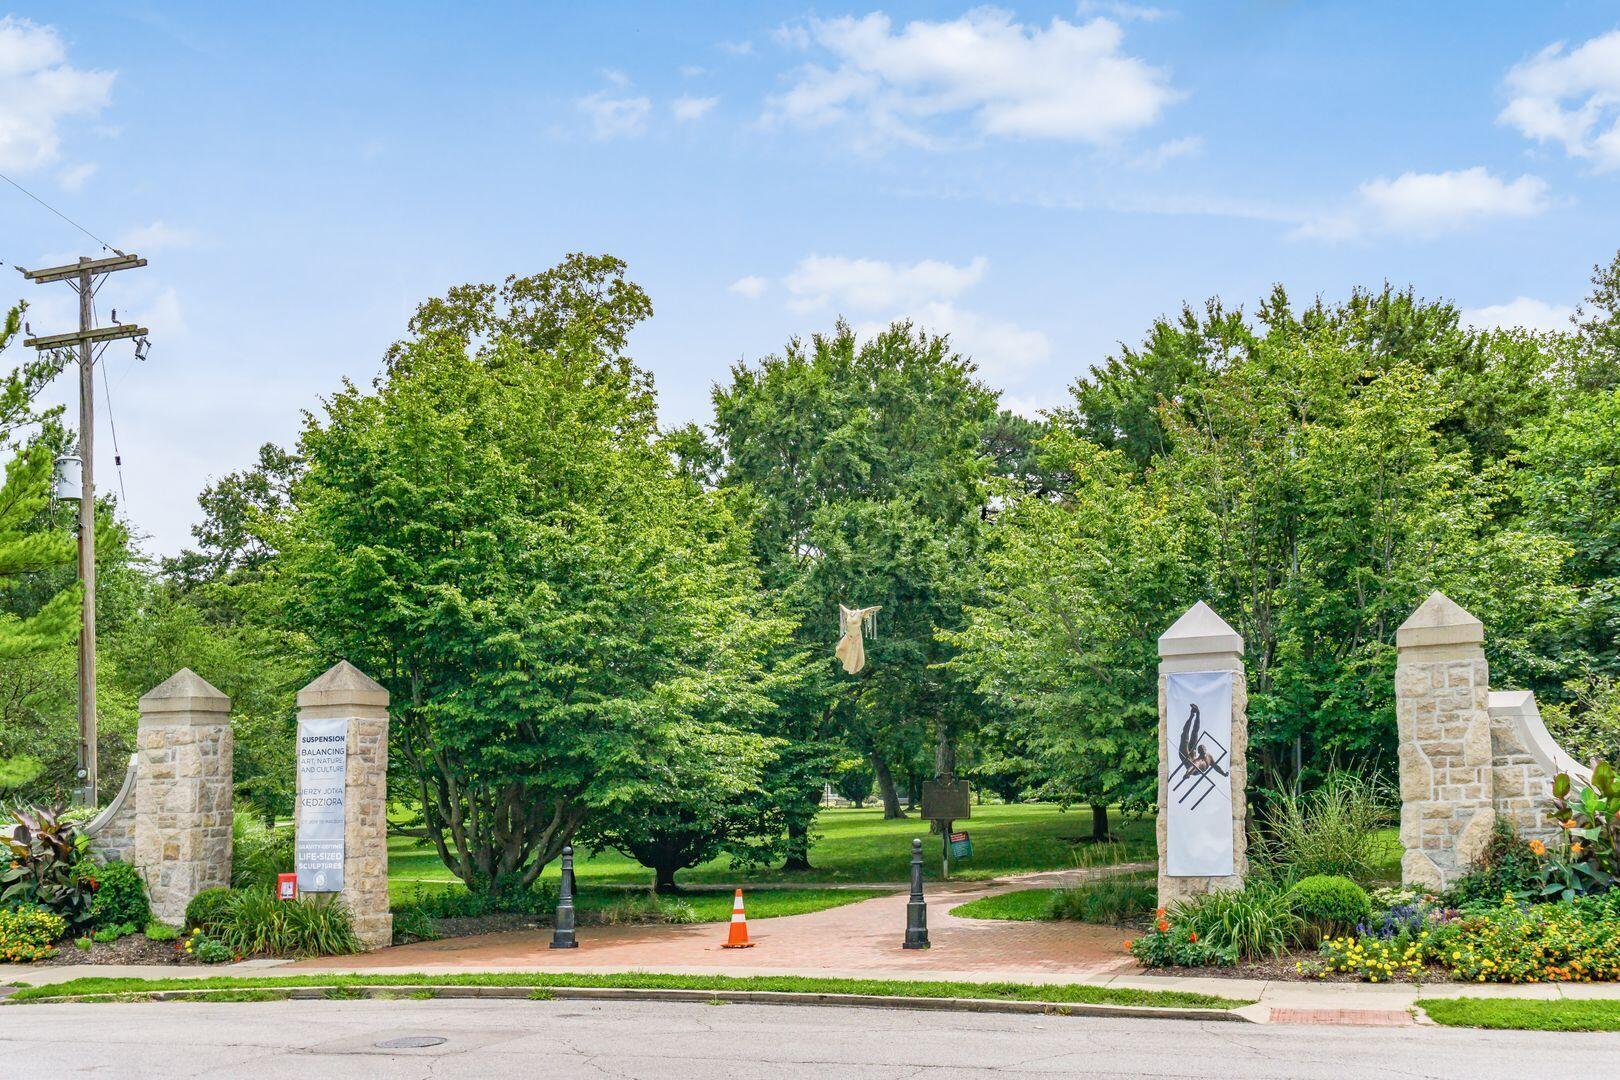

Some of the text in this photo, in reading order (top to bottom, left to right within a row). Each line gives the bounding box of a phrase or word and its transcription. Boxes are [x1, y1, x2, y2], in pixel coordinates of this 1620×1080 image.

[302, 736, 345, 744] SUSPENSION
[302, 748, 344, 756] BALANCING
[298, 852, 342, 861] LIFE-SIZED
